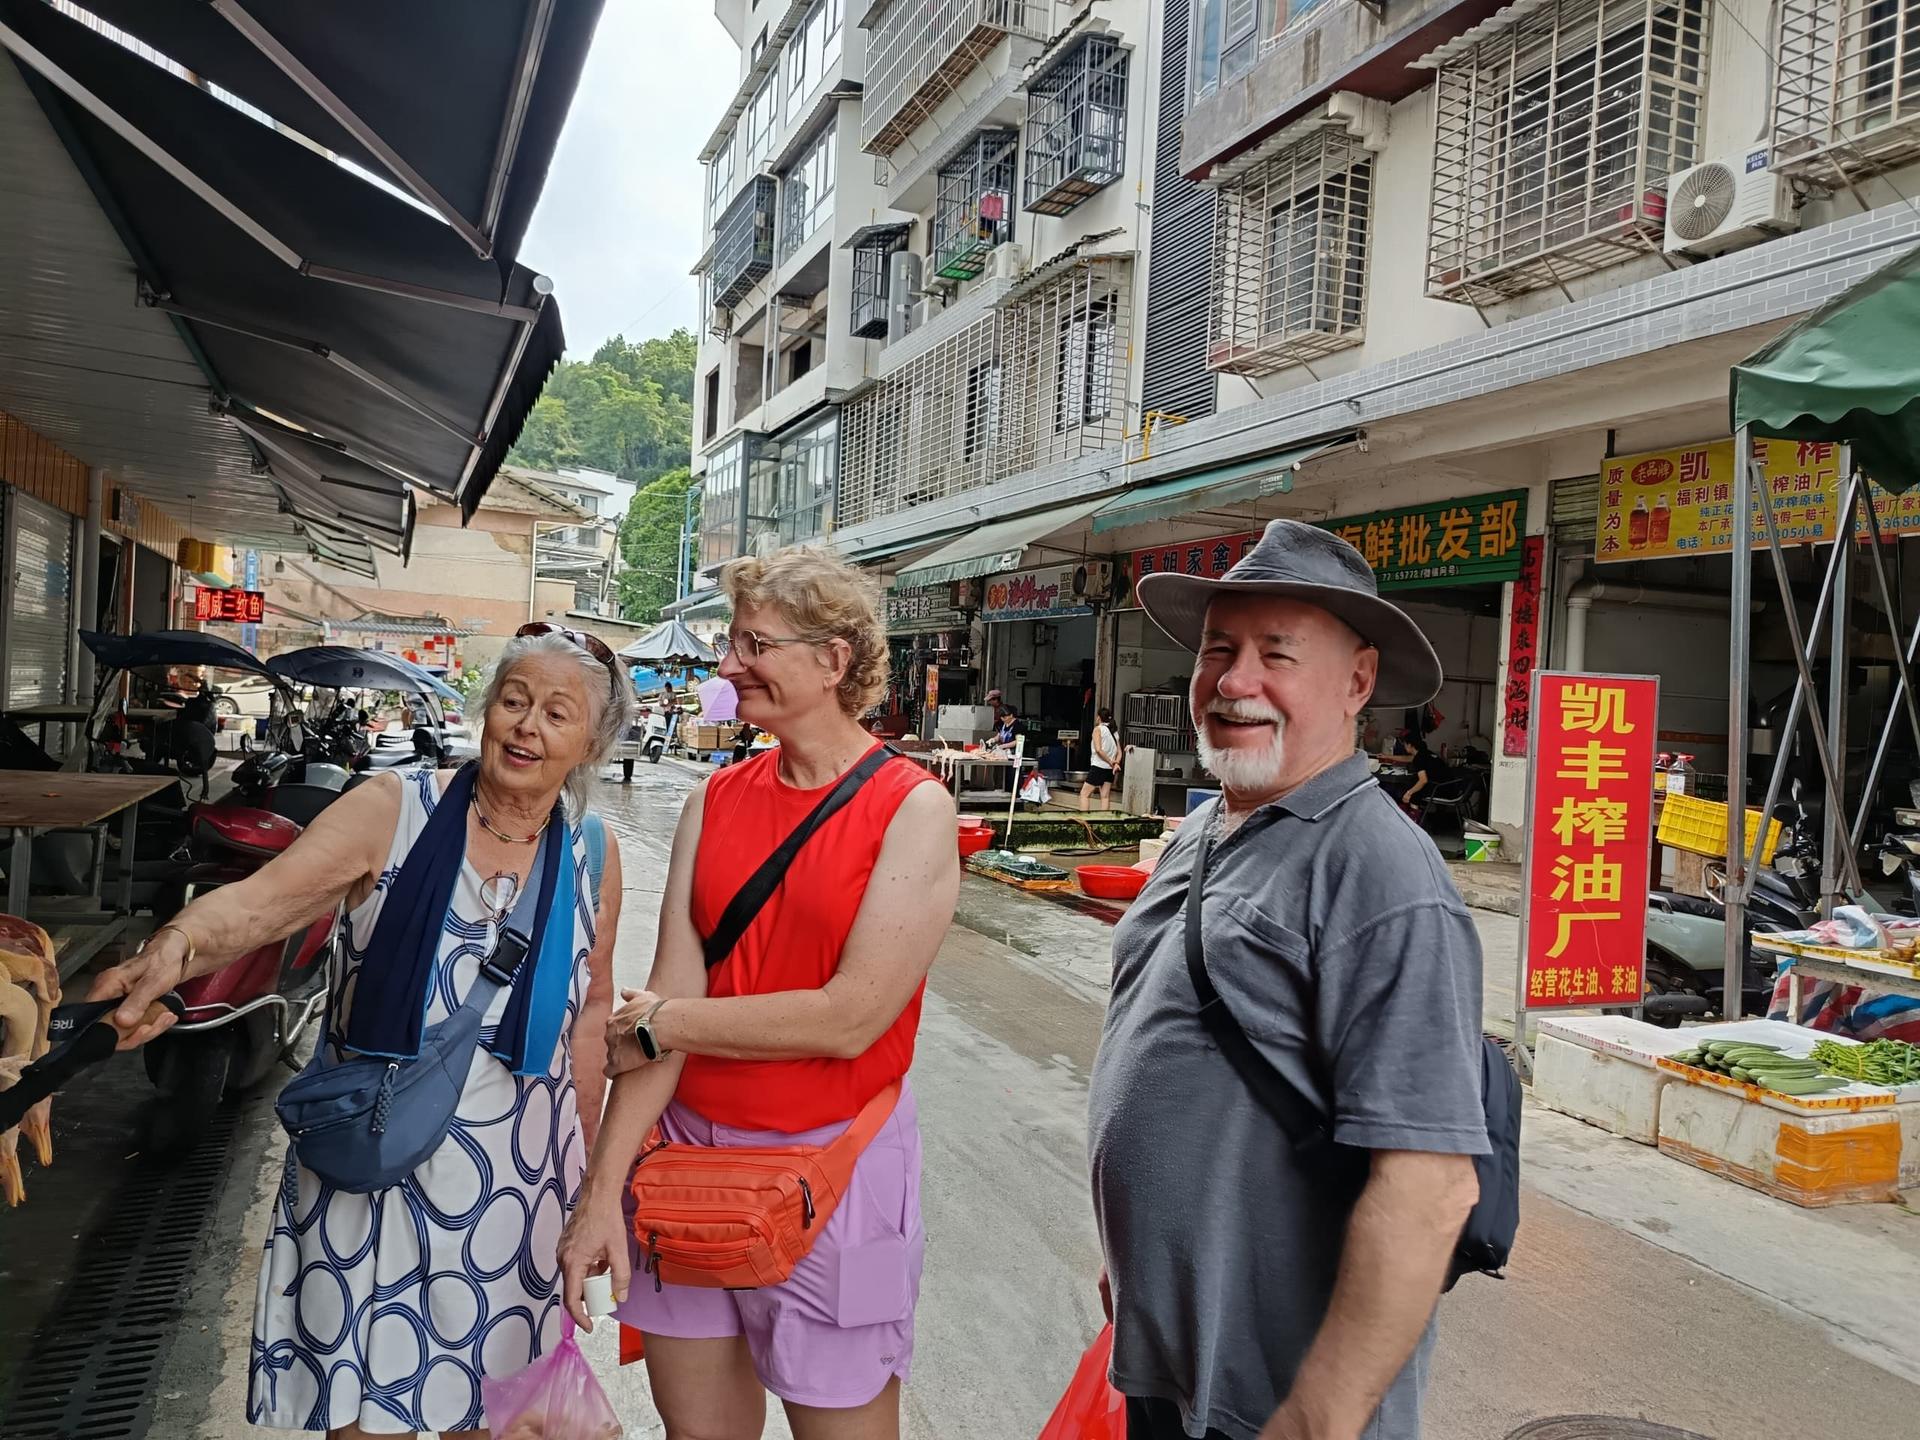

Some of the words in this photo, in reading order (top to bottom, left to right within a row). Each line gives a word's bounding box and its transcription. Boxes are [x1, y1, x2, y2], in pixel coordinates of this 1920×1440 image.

[1676, 470, 1833, 507] 福利镇榨油厂
[1602, 467, 1625, 552] 质量为本
[198, 591, 260, 619] 挪威三纹鱼
[1545, 683, 1635, 958] 凯丰榨油厂
[1530, 965, 1638, 998] 经营花生油、茶油
[50, 1018, 76, 1031] TRE
